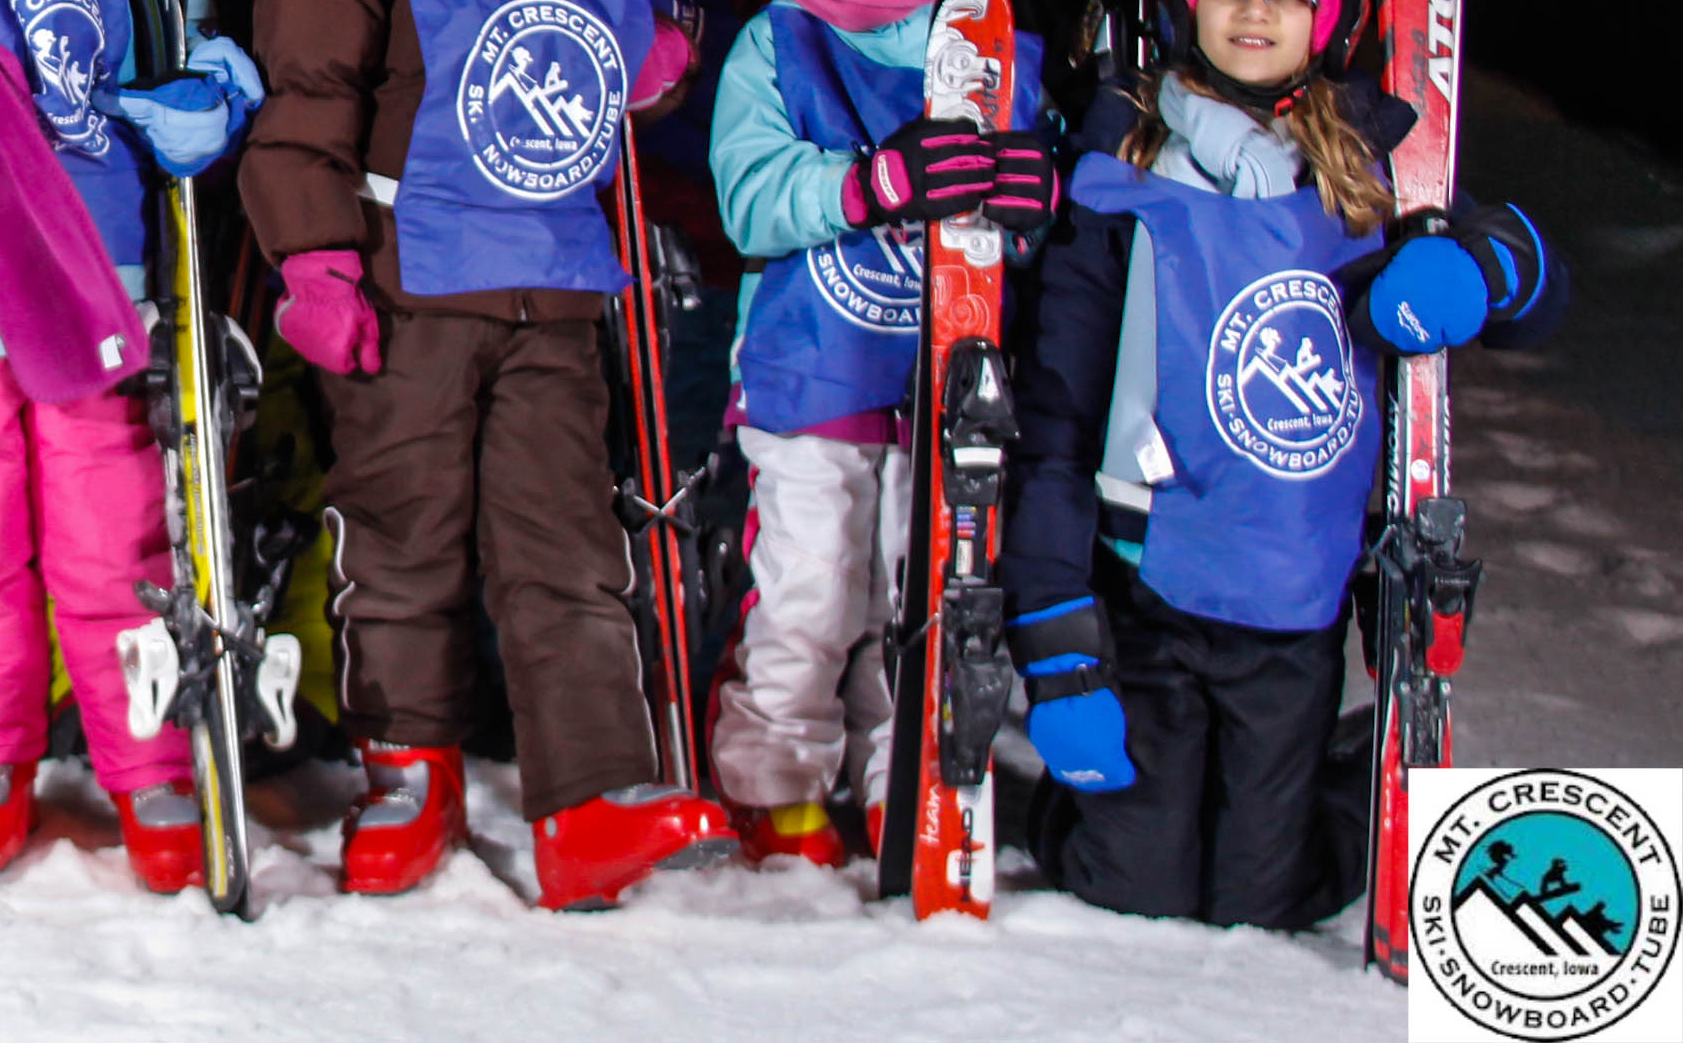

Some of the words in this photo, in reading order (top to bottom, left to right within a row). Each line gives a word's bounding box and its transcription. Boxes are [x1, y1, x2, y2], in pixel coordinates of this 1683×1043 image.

[481, 26, 509, 64] MT.
[508, 5, 618, 70] CRESCENT
[594, 91, 621, 151] TUBE
[482, 143, 594, 188] NOWBOARD
[1220, 311, 1253, 353] MT.
[1218, 373, 1236, 412] SKI
[1228, 417, 1350, 470] SNOWBOARD
